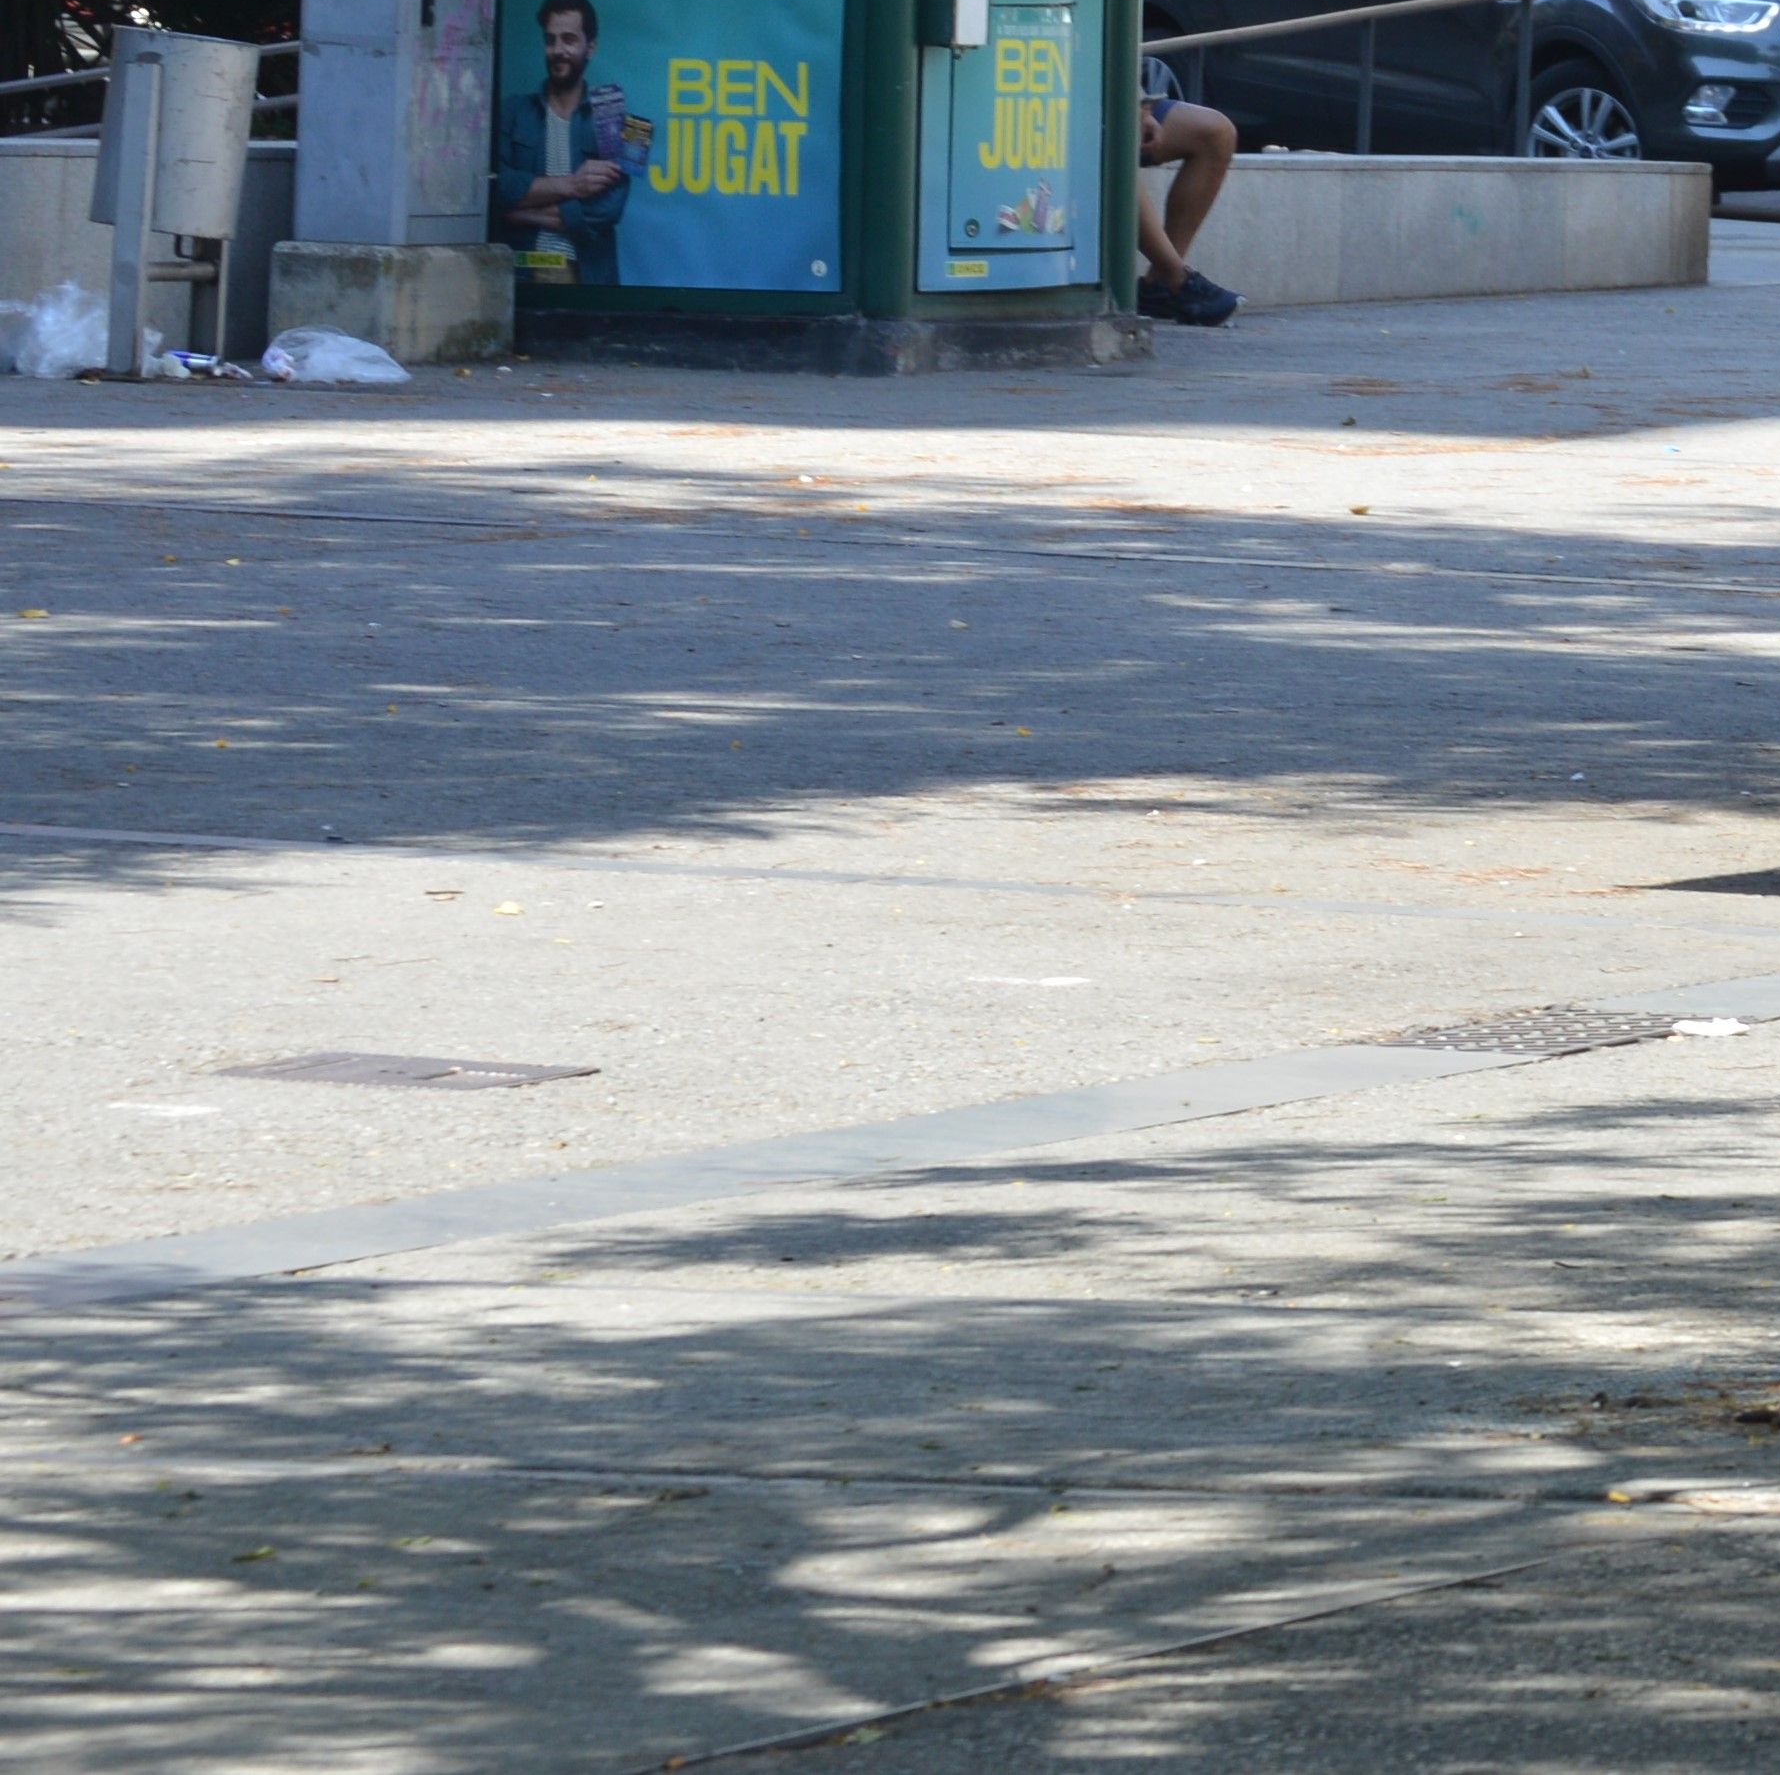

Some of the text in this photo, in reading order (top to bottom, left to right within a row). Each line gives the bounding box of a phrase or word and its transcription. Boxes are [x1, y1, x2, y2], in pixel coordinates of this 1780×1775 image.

[667, 57, 811, 118] BEN
[995, 37, 1071, 95] BEN
[647, 117, 809, 197] JUGAT
[978, 96, 1068, 171] JUGAT
